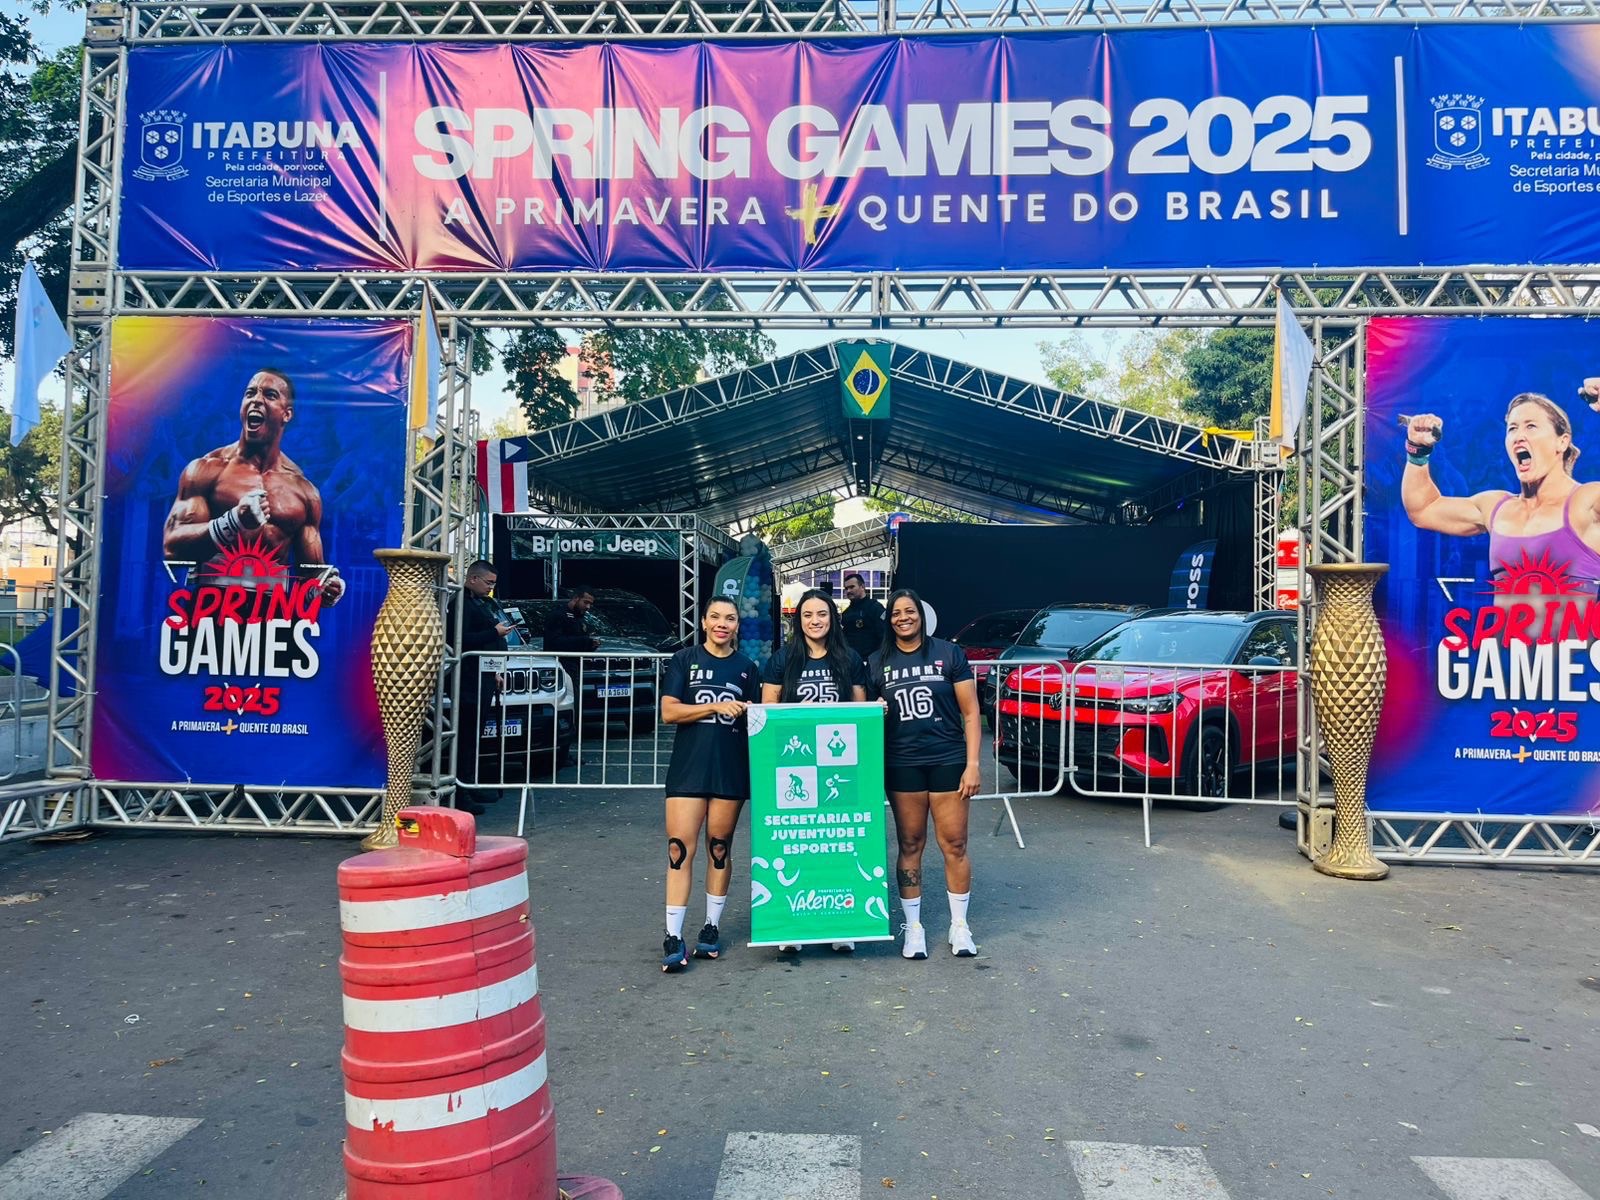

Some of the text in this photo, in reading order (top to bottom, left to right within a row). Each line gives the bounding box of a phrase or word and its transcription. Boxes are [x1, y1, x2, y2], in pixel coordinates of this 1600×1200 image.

[192, 121, 361, 148] ITABUNA
[412, 95, 1372, 180] SPRING GAMES 2025
[207, 151, 345, 160] PREFEITURA
[1531, 151, 1552, 160] Pela
[1555, 151, 1592, 160] cidade,
[225, 163, 327, 173] Pela cidade, por você.
[1510, 164, 1579, 176] Secretaria
[205, 175, 332, 188] Secretaria Municipal
[1513, 181, 1531, 192] de
[1534, 180, 1594, 195] Esportes
[208, 190, 328, 205] de Esportes e Lazer
[444, 197, 470, 225] A
[496, 197, 766, 225] PRIMAVERA
[858, 193, 1046, 231] QUENTE
[1073, 192, 1139, 222] DO
[1166, 189, 1338, 220] BRASIL
[607, 534, 659, 556] Jeep
[165, 578, 323, 631] SPRING
[159, 615, 321, 679] GAMES
[689, 669, 713, 680] FAU
[883, 665, 943, 682] THAMMY
[796, 682, 840, 703] 25
[203, 686, 281, 715] 2025
[894, 686, 934, 721] 16
[171, 720, 177, 731] A
[179, 721, 221, 732] PRIMAVERA
[239, 722, 269, 733] QUENTE
[270, 723, 280, 733] DO
[282, 723, 309, 735] BRASIL
[1490, 711, 1578, 743] 2025
[1454, 747, 1461, 758] A
[1462, 747, 1512, 760] PRIMAVERA
[1533, 749, 1567, 761] QUENTE
[1568, 750, 1580, 762] DO
[764, 811, 872, 826] SECRETARIA DE
[771, 827, 866, 841] JUVENTUDE E
[783, 842, 855, 855] ESPORTES
